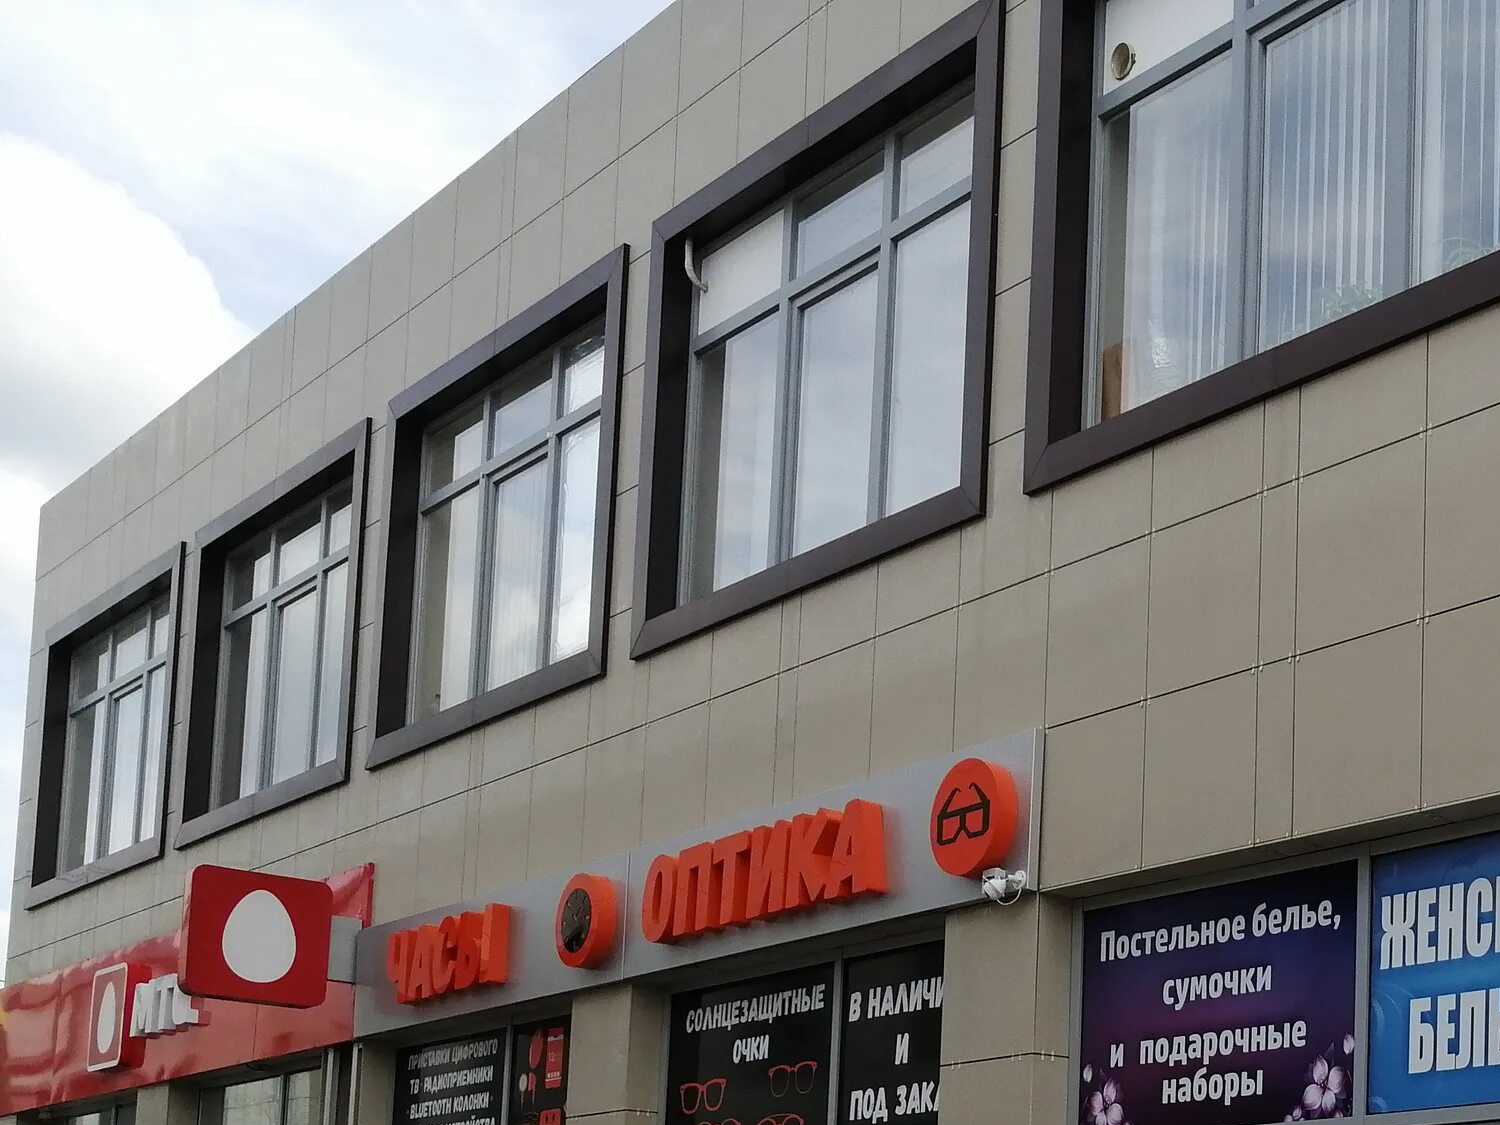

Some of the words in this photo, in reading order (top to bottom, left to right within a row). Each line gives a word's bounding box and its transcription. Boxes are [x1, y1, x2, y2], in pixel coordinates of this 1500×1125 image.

[642, 798, 888, 944] ОПТИКА
[1100, 911, 1245, 964] Постельное
[1252, 900, 1342, 940] белье,
[386, 902, 513, 1004] ЧАСЫ
[1162, 964, 1272, 1011] сумочки
[686, 984, 826, 1034] СОЛНЦЕЗАЩИТНЫЕ
[848, 992, 862, 1022] В
[408, 1048, 450, 1070] ПРИСТАВКИ
[452, 1038, 498, 1064] ЦИФРОВОГО
[732, 1034, 770, 1064] ОЧКИ
[894, 1032, 910, 1065] И
[1110, 1044, 1124, 1068] и
[1139, 1019, 1307, 1069] подарочные
[410, 1079, 419, 1094] ТВ
[424, 1065, 494, 1094] РАДИОПРИЕМНИКИ
[1162, 1067, 1264, 1106] наборы
[410, 1098, 452, 1120] BLUETOOTH
[453, 1092, 490, 1112] КОЛОНКИ
[849, 1087, 888, 1124] ПОД
